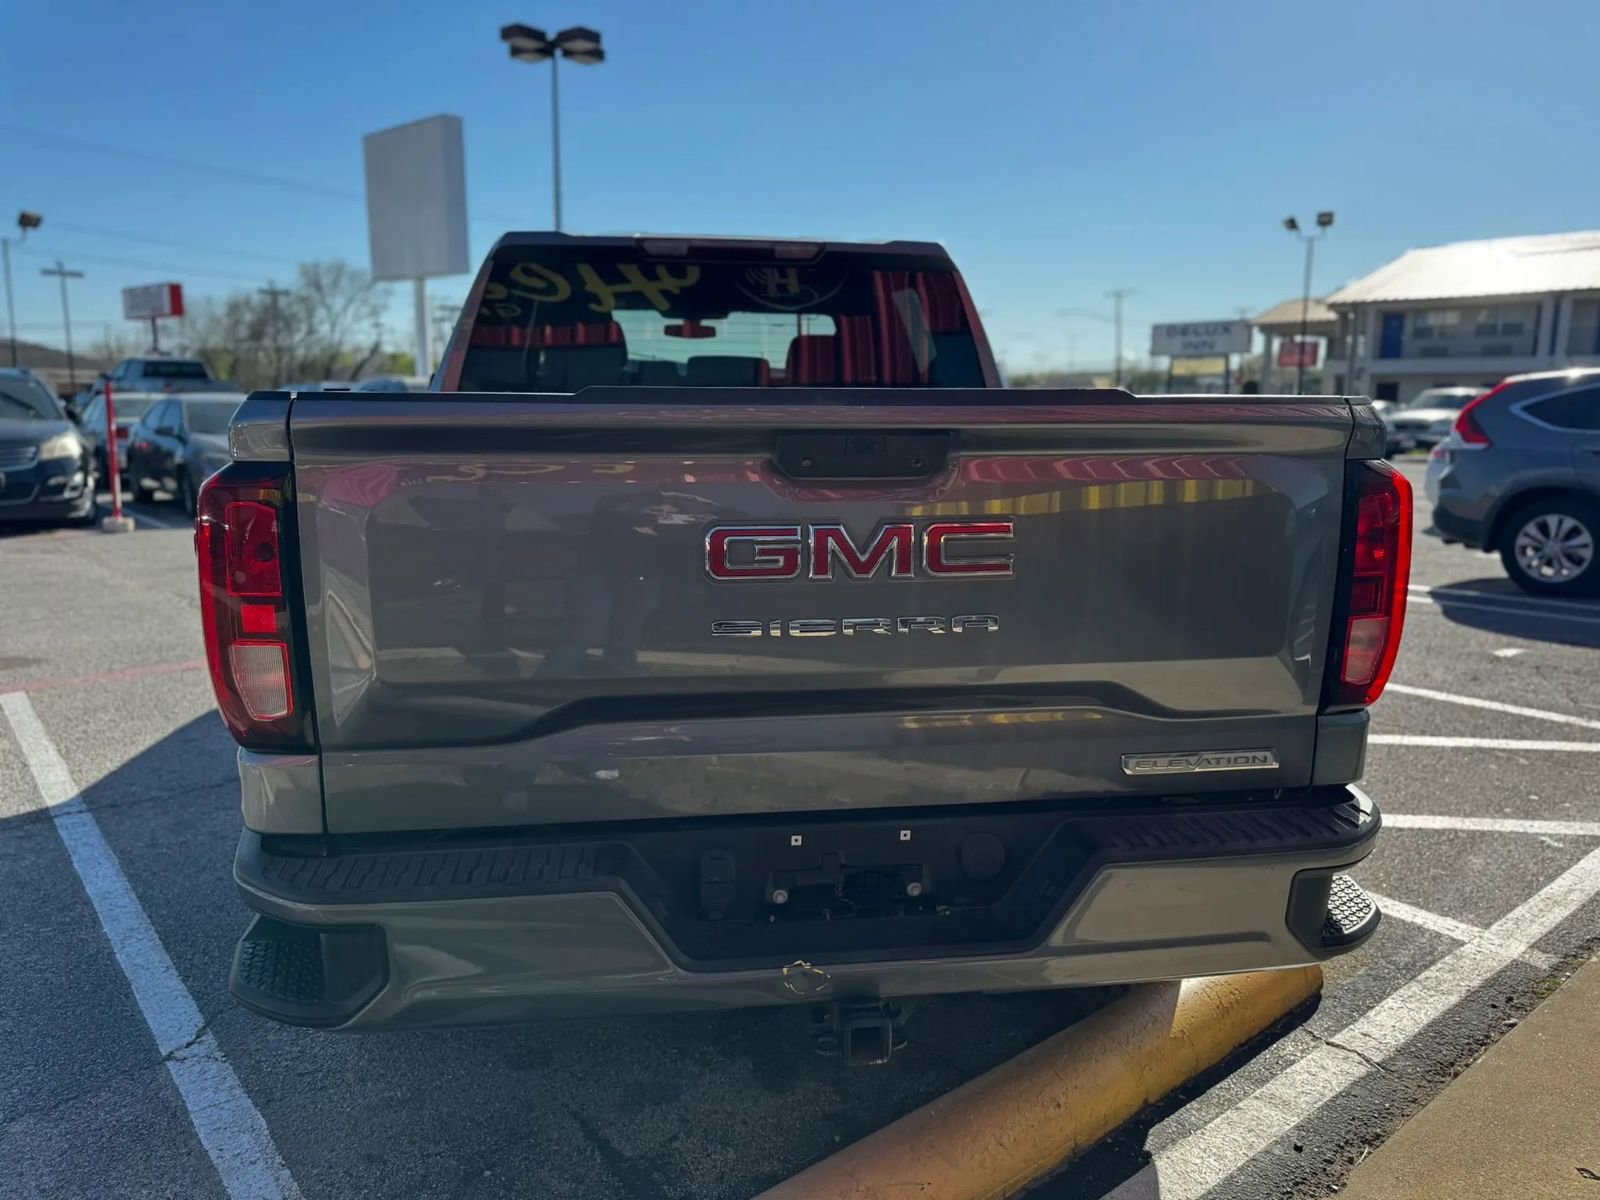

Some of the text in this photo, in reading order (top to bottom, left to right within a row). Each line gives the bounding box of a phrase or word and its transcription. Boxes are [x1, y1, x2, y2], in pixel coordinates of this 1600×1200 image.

[705, 522, 1015, 581] GMC
[711, 614, 1000, 637] SIERRA
[1135, 754, 1269, 770] ELEVATION
